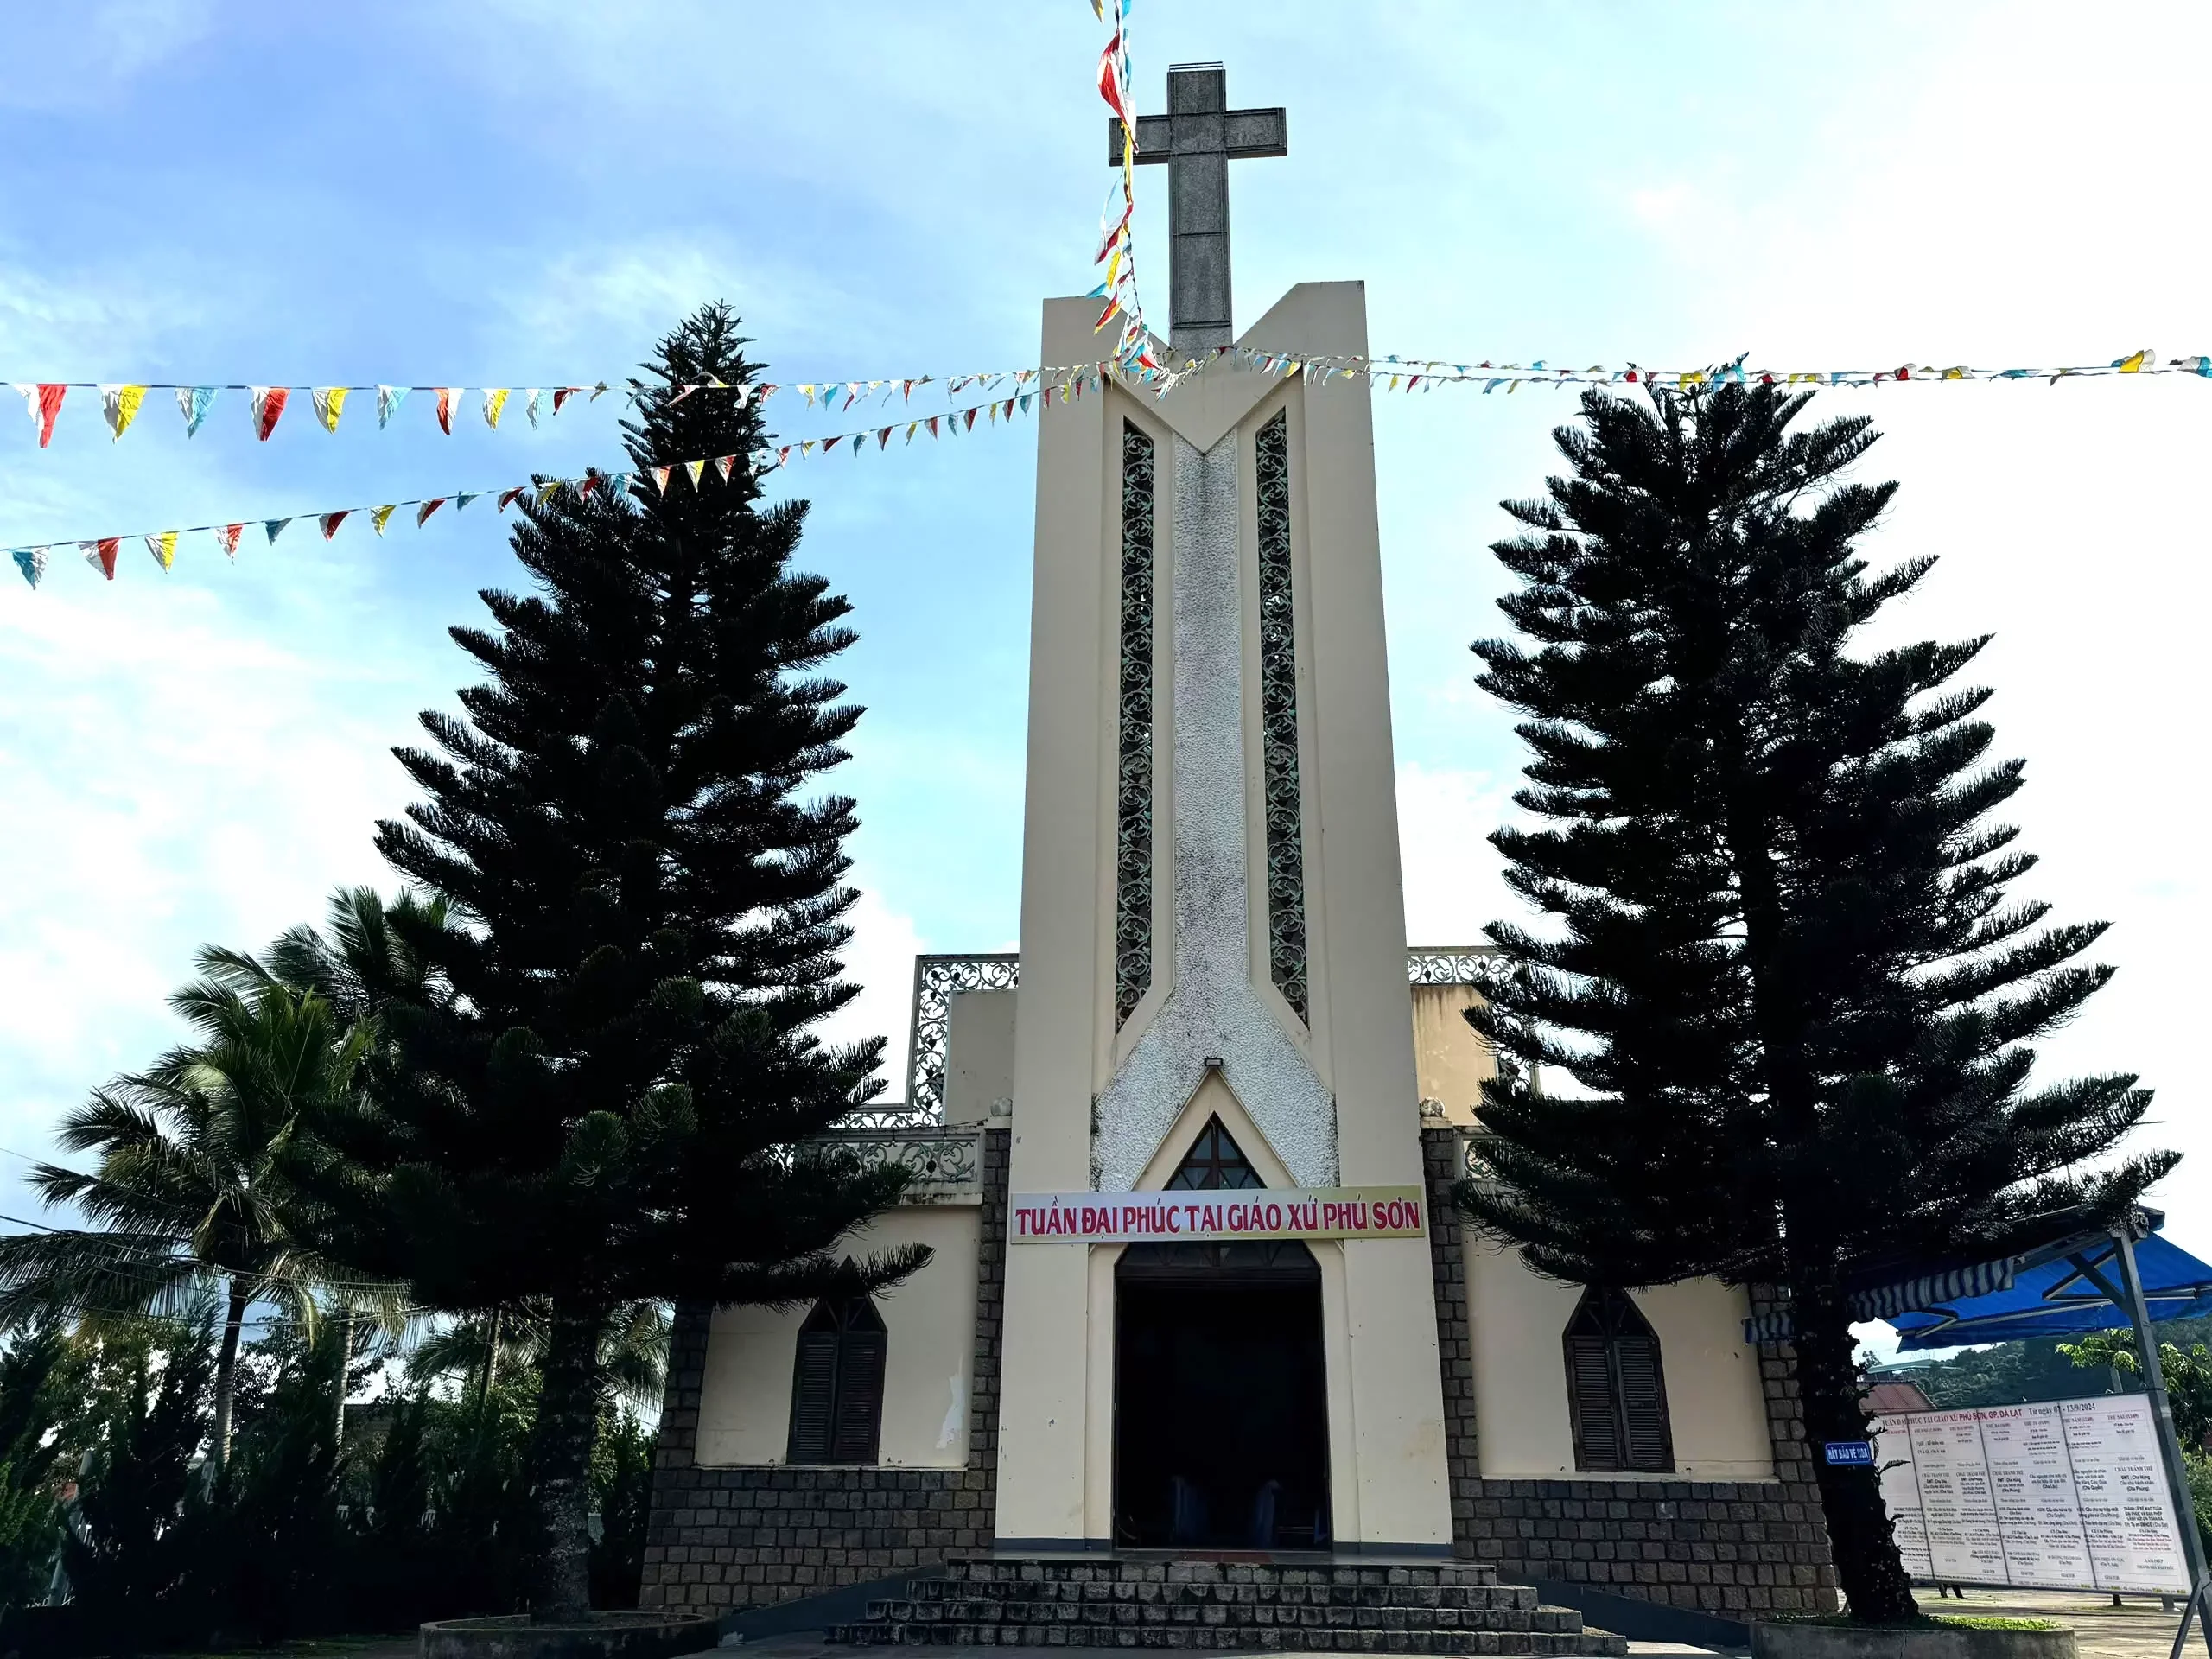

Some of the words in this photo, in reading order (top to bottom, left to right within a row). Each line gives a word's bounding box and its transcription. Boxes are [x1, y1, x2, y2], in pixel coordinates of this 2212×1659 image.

[1015, 1195, 1077, 1236] TUẦN
[1081, 1207, 1120, 1239] ĐẠI
[1122, 1197, 1182, 1234] PHÚC
[1184, 1205, 1223, 1238] TẠI
[1227, 1195, 1281, 1231] GIÁO
[1287, 1194, 1319, 1231] XỨ
[1323, 1193, 1368, 1230] PHÚ
[1372, 1196, 1421, 1230] SƠN
[2066, 1402, 2096, 1413] 13/9/2024
